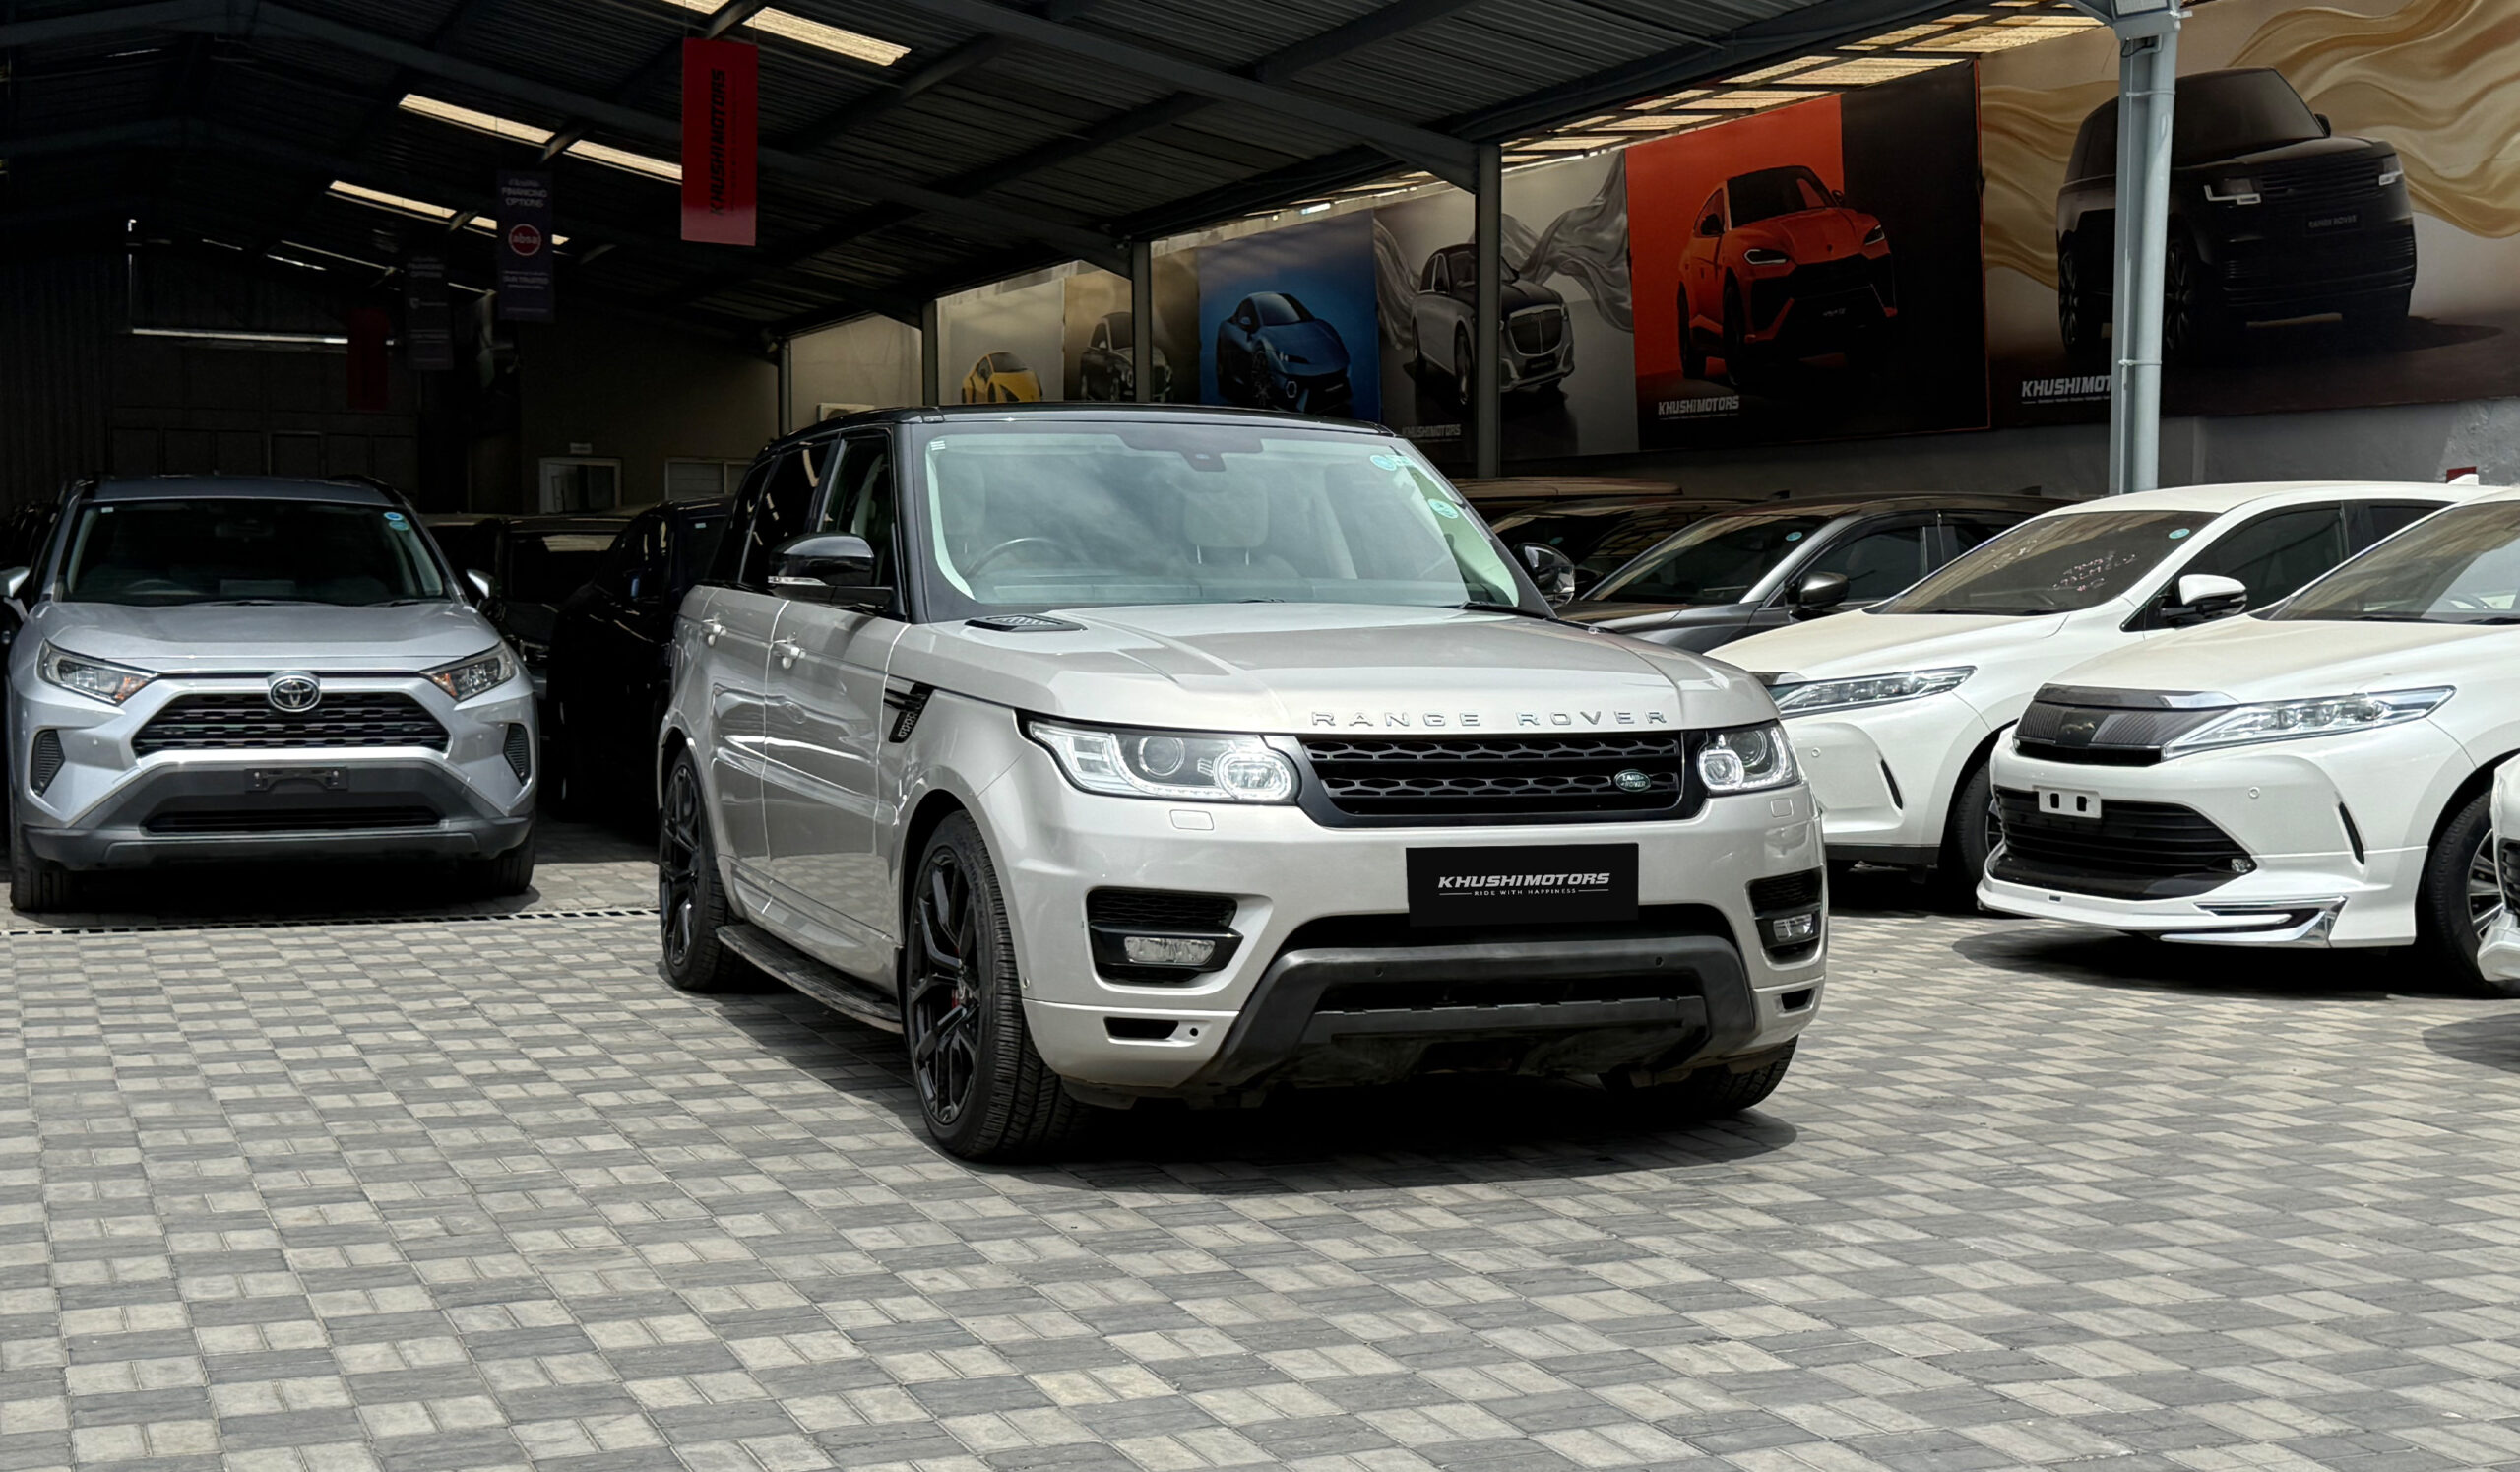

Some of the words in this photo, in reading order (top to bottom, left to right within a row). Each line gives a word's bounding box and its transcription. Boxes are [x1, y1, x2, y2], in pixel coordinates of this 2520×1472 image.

[709, 68, 726, 216] KHUSHIMOTORS
[2020, 374, 2111, 398] KHUSHIMOT
[1657, 395, 1740, 416] KHUSHIMOTORS
[1310, 711, 1481, 728] RANGE
[1516, 710, 1668, 727] ROVER
[1437, 872, 1611, 888] KHUSHIMOTORS
